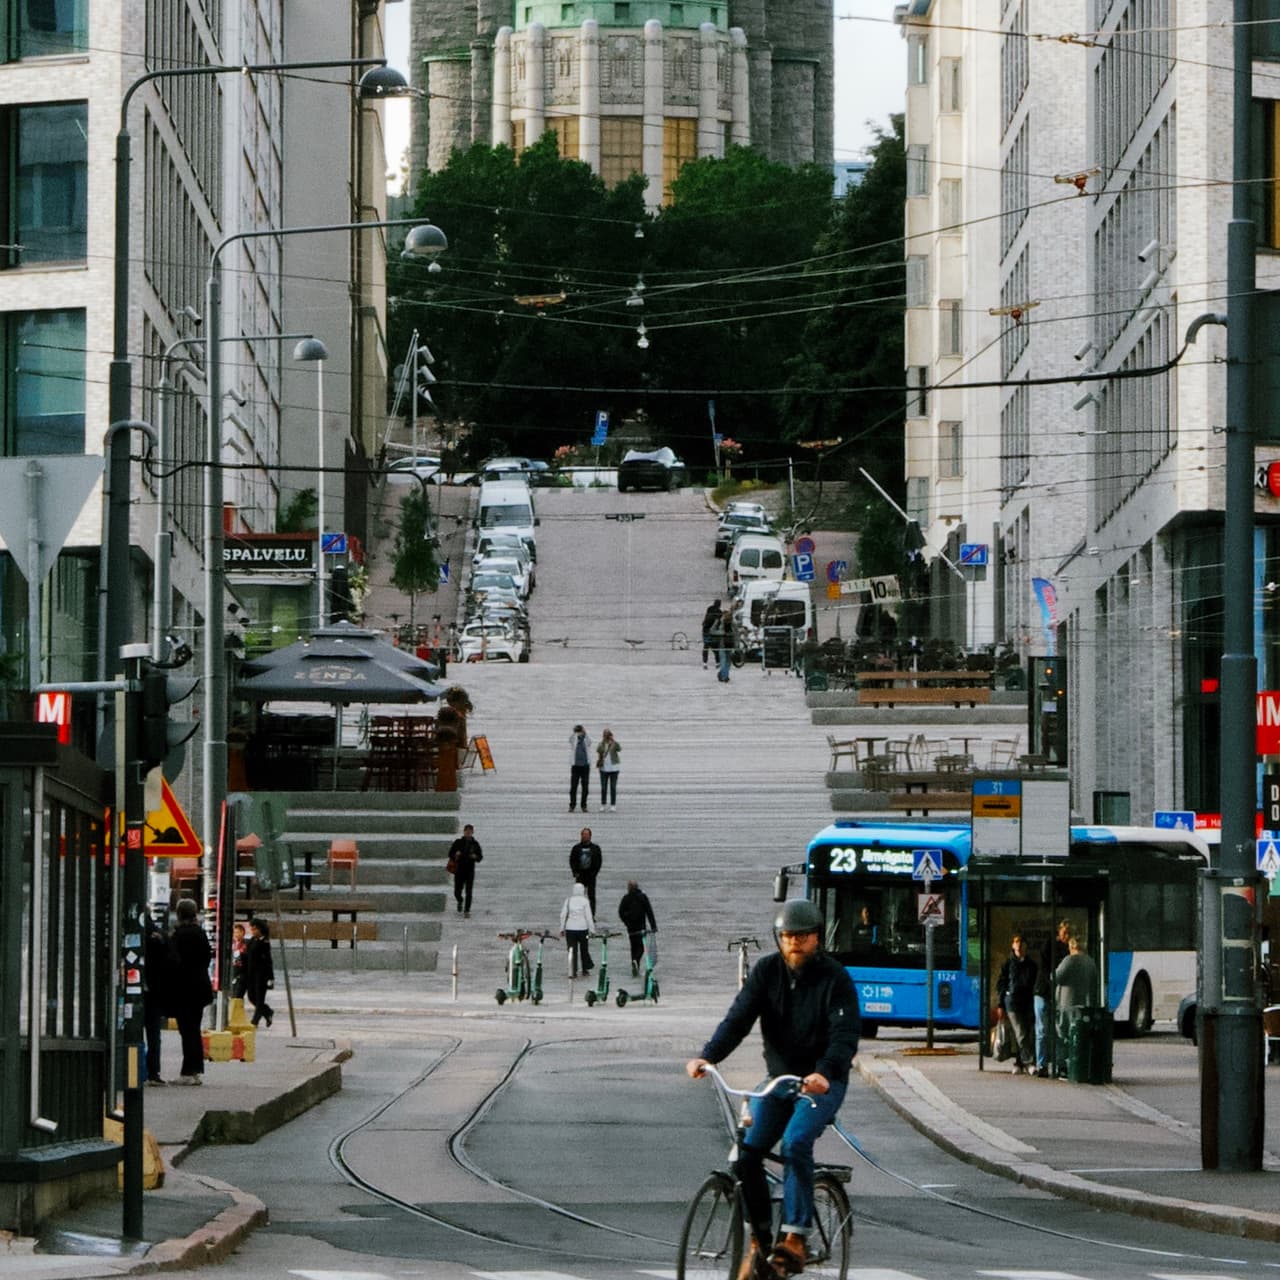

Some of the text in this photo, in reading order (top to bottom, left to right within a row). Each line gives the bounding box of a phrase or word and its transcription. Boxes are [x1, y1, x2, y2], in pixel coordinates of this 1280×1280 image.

[797, 554, 811, 572] P
[870, 581, 887, 599] 10
[38, 694, 65, 725] M
[829, 847, 857, 873] 23
[937, 972, 956, 981] 1124
